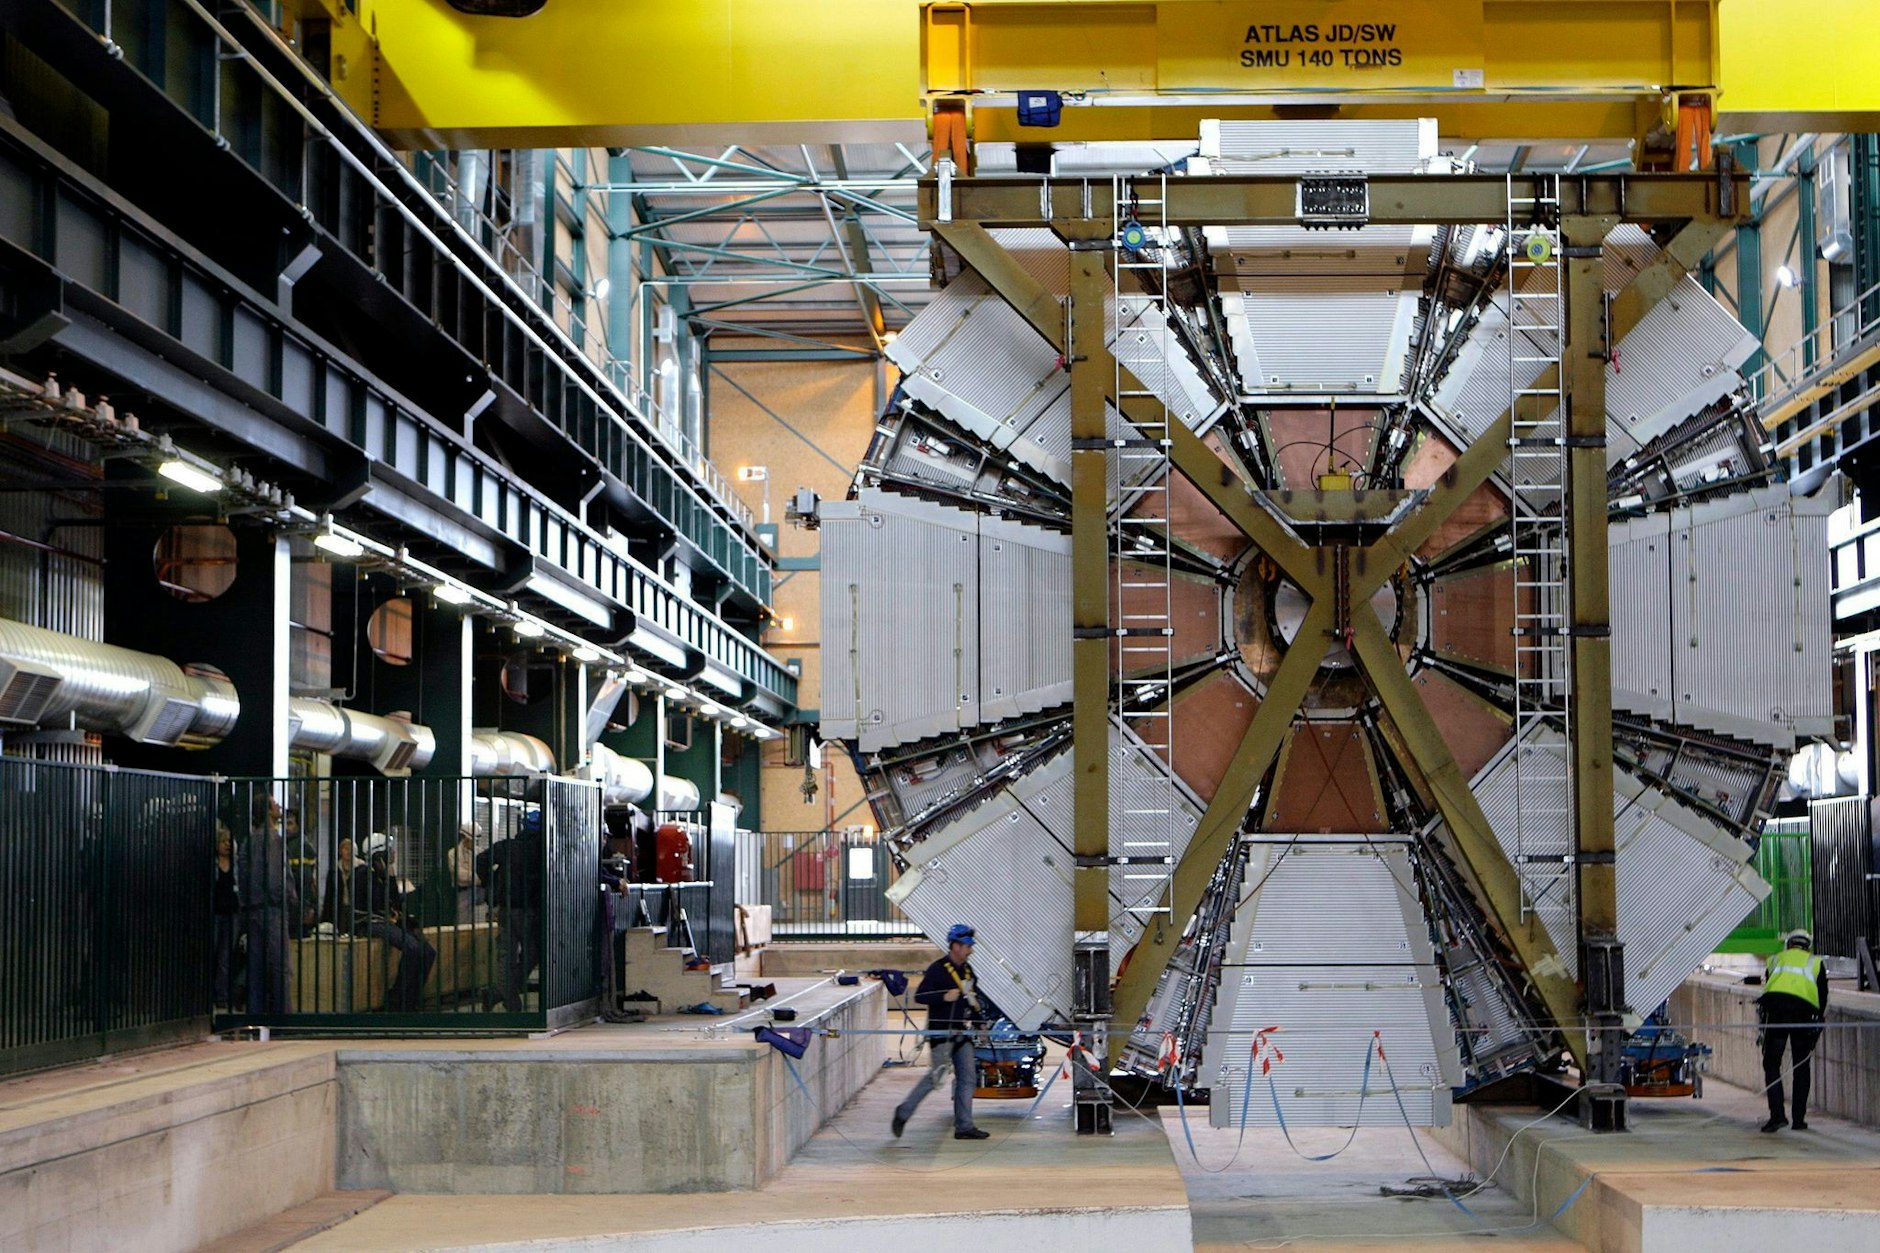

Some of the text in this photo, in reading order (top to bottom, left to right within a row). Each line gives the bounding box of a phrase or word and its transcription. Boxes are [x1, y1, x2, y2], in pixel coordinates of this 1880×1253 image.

[1245, 24, 1396, 43] ATLAS JD/SW
[1240, 48, 1402, 67] SMU 140 TONS
